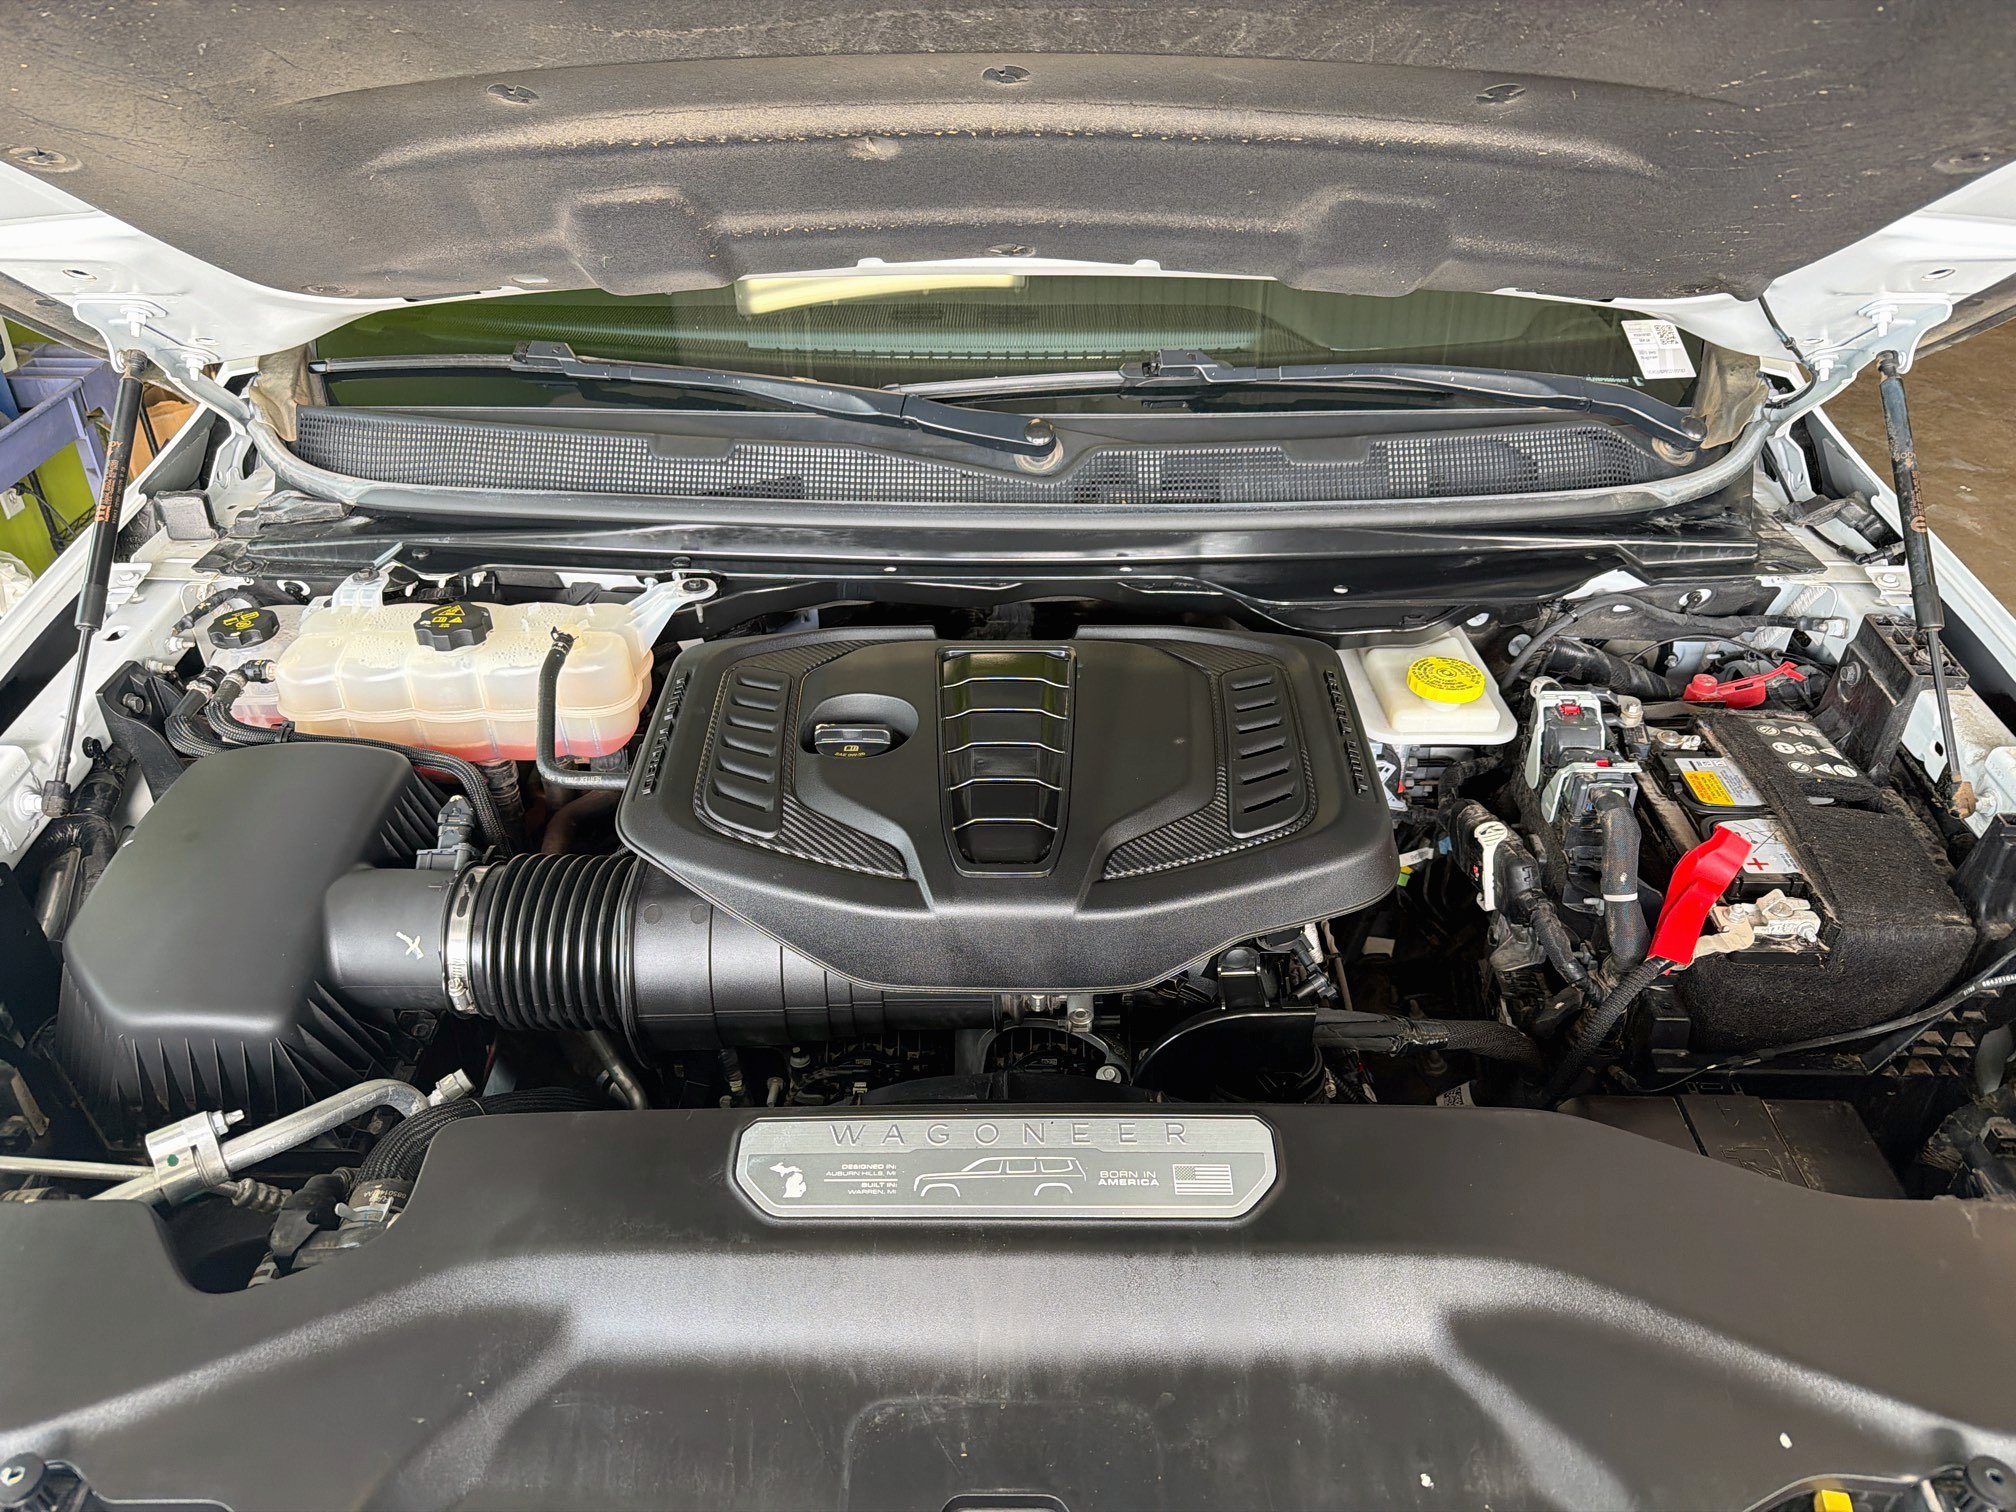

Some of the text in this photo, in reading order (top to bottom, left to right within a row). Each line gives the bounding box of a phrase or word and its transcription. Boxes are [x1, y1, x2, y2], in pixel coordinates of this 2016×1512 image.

[829, 1122, 1187, 1147] WAGONEER
[1100, 1170, 1157, 1179] BORN IN
[1098, 1178, 1160, 1186] AMERICA
